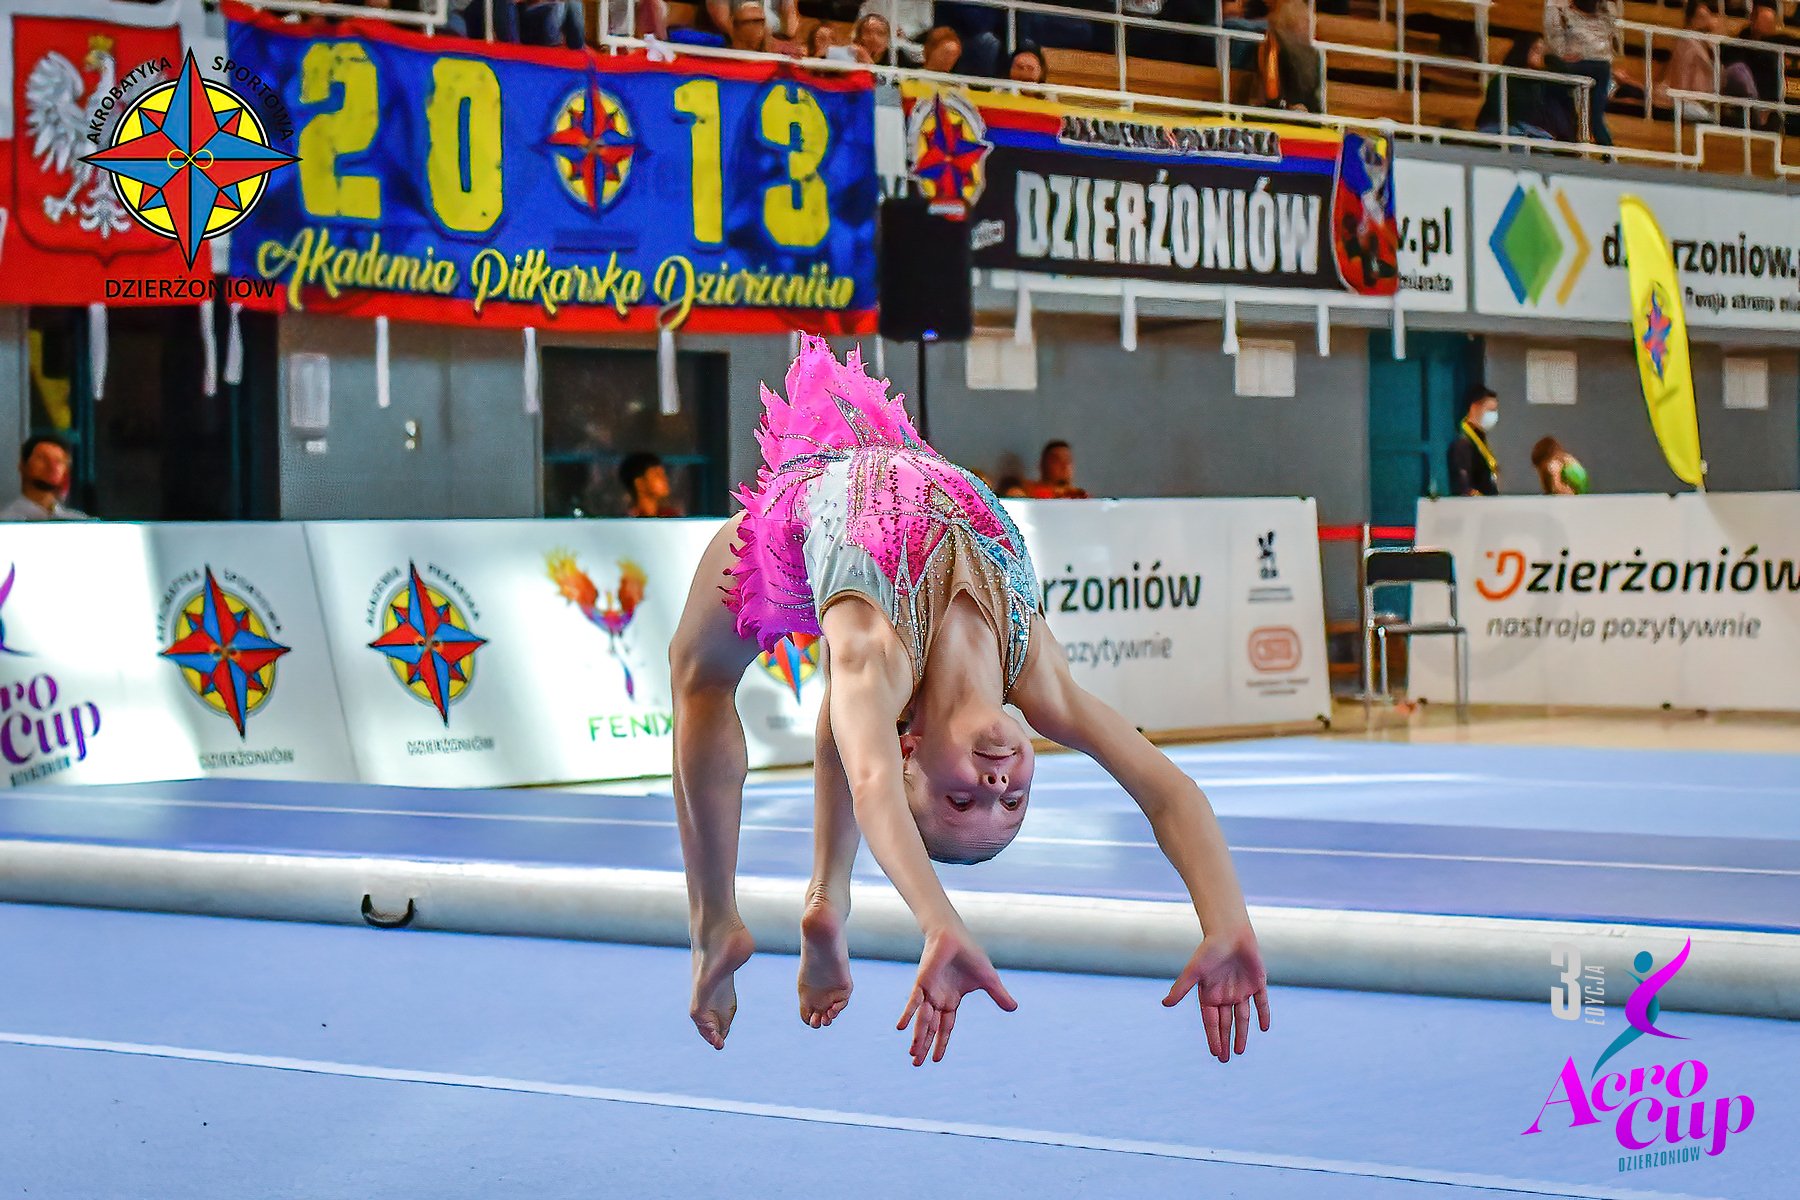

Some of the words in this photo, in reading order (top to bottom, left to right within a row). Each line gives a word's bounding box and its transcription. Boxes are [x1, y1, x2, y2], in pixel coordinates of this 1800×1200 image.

[256, 226, 461, 311] Akademia
[471, 247, 643, 316] Piłkarska
[1042, 560, 1202, 613] rżoniów
[1475, 546, 1800, 601] Dzierżoniów
[1065, 631, 1173, 669] ozytywnie
[1601, 613, 1762, 645] pozytywnie
[0, 673, 58, 713] ro
[0, 701, 101, 765] Cup
[588, 711, 673, 742] FENIX
